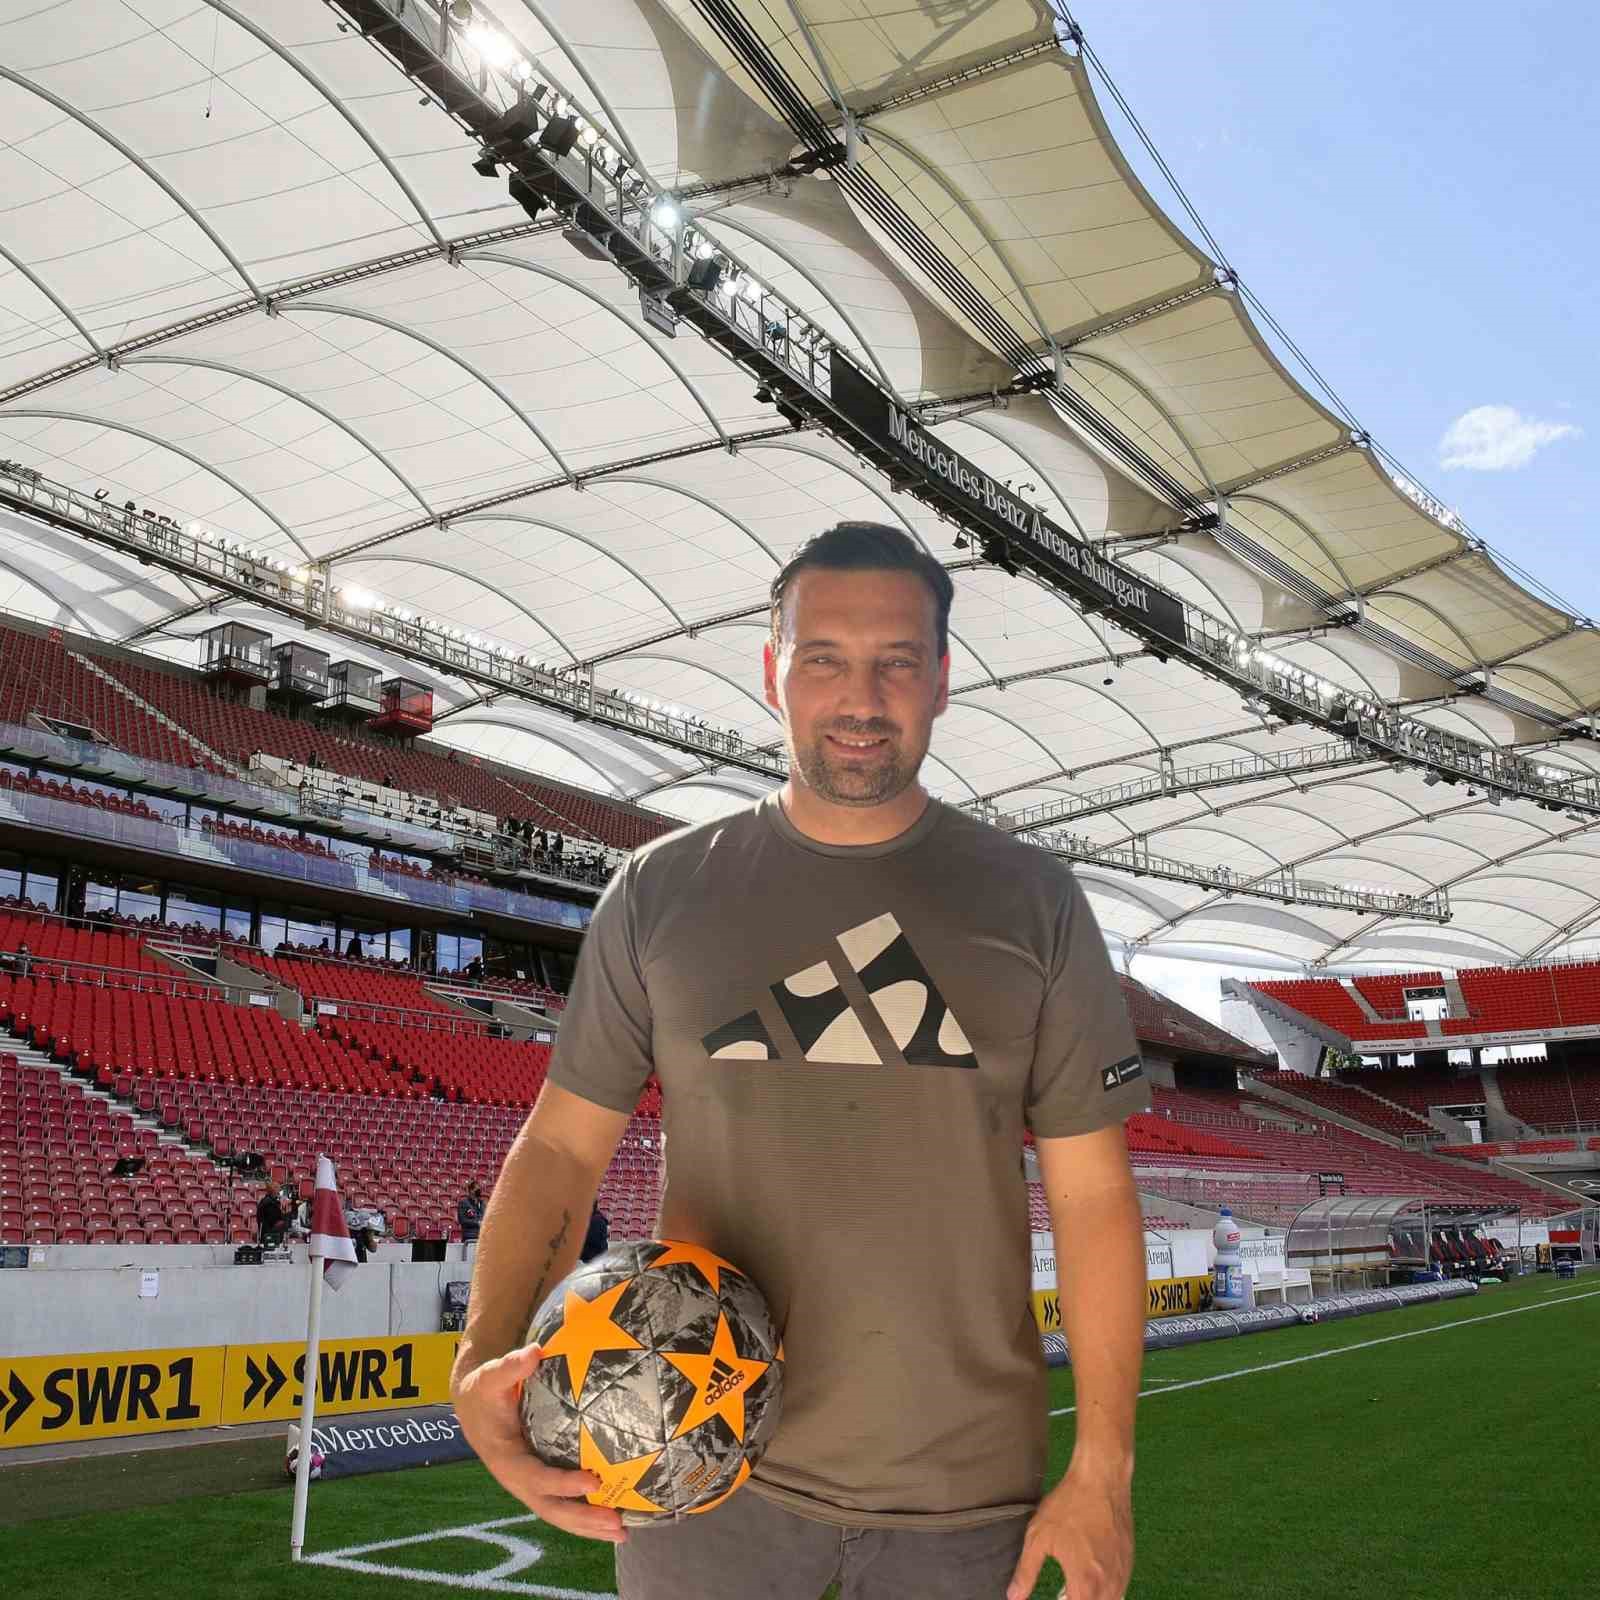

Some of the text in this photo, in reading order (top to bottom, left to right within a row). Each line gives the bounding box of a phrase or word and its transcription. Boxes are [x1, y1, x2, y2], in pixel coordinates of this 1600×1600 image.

[887, 402, 1150, 613] Mercedes-Benz Arena Stuttgart
[1032, 1254, 1056, 1273] Aren
[1147, 1247, 1170, 1265] Arena
[1160, 1280, 1193, 1312] SWR1
[40, 1356, 201, 1430] SWR1
[704, 1370, 745, 1406] adidas
[311, 1413, 461, 1456] Mercedes-
